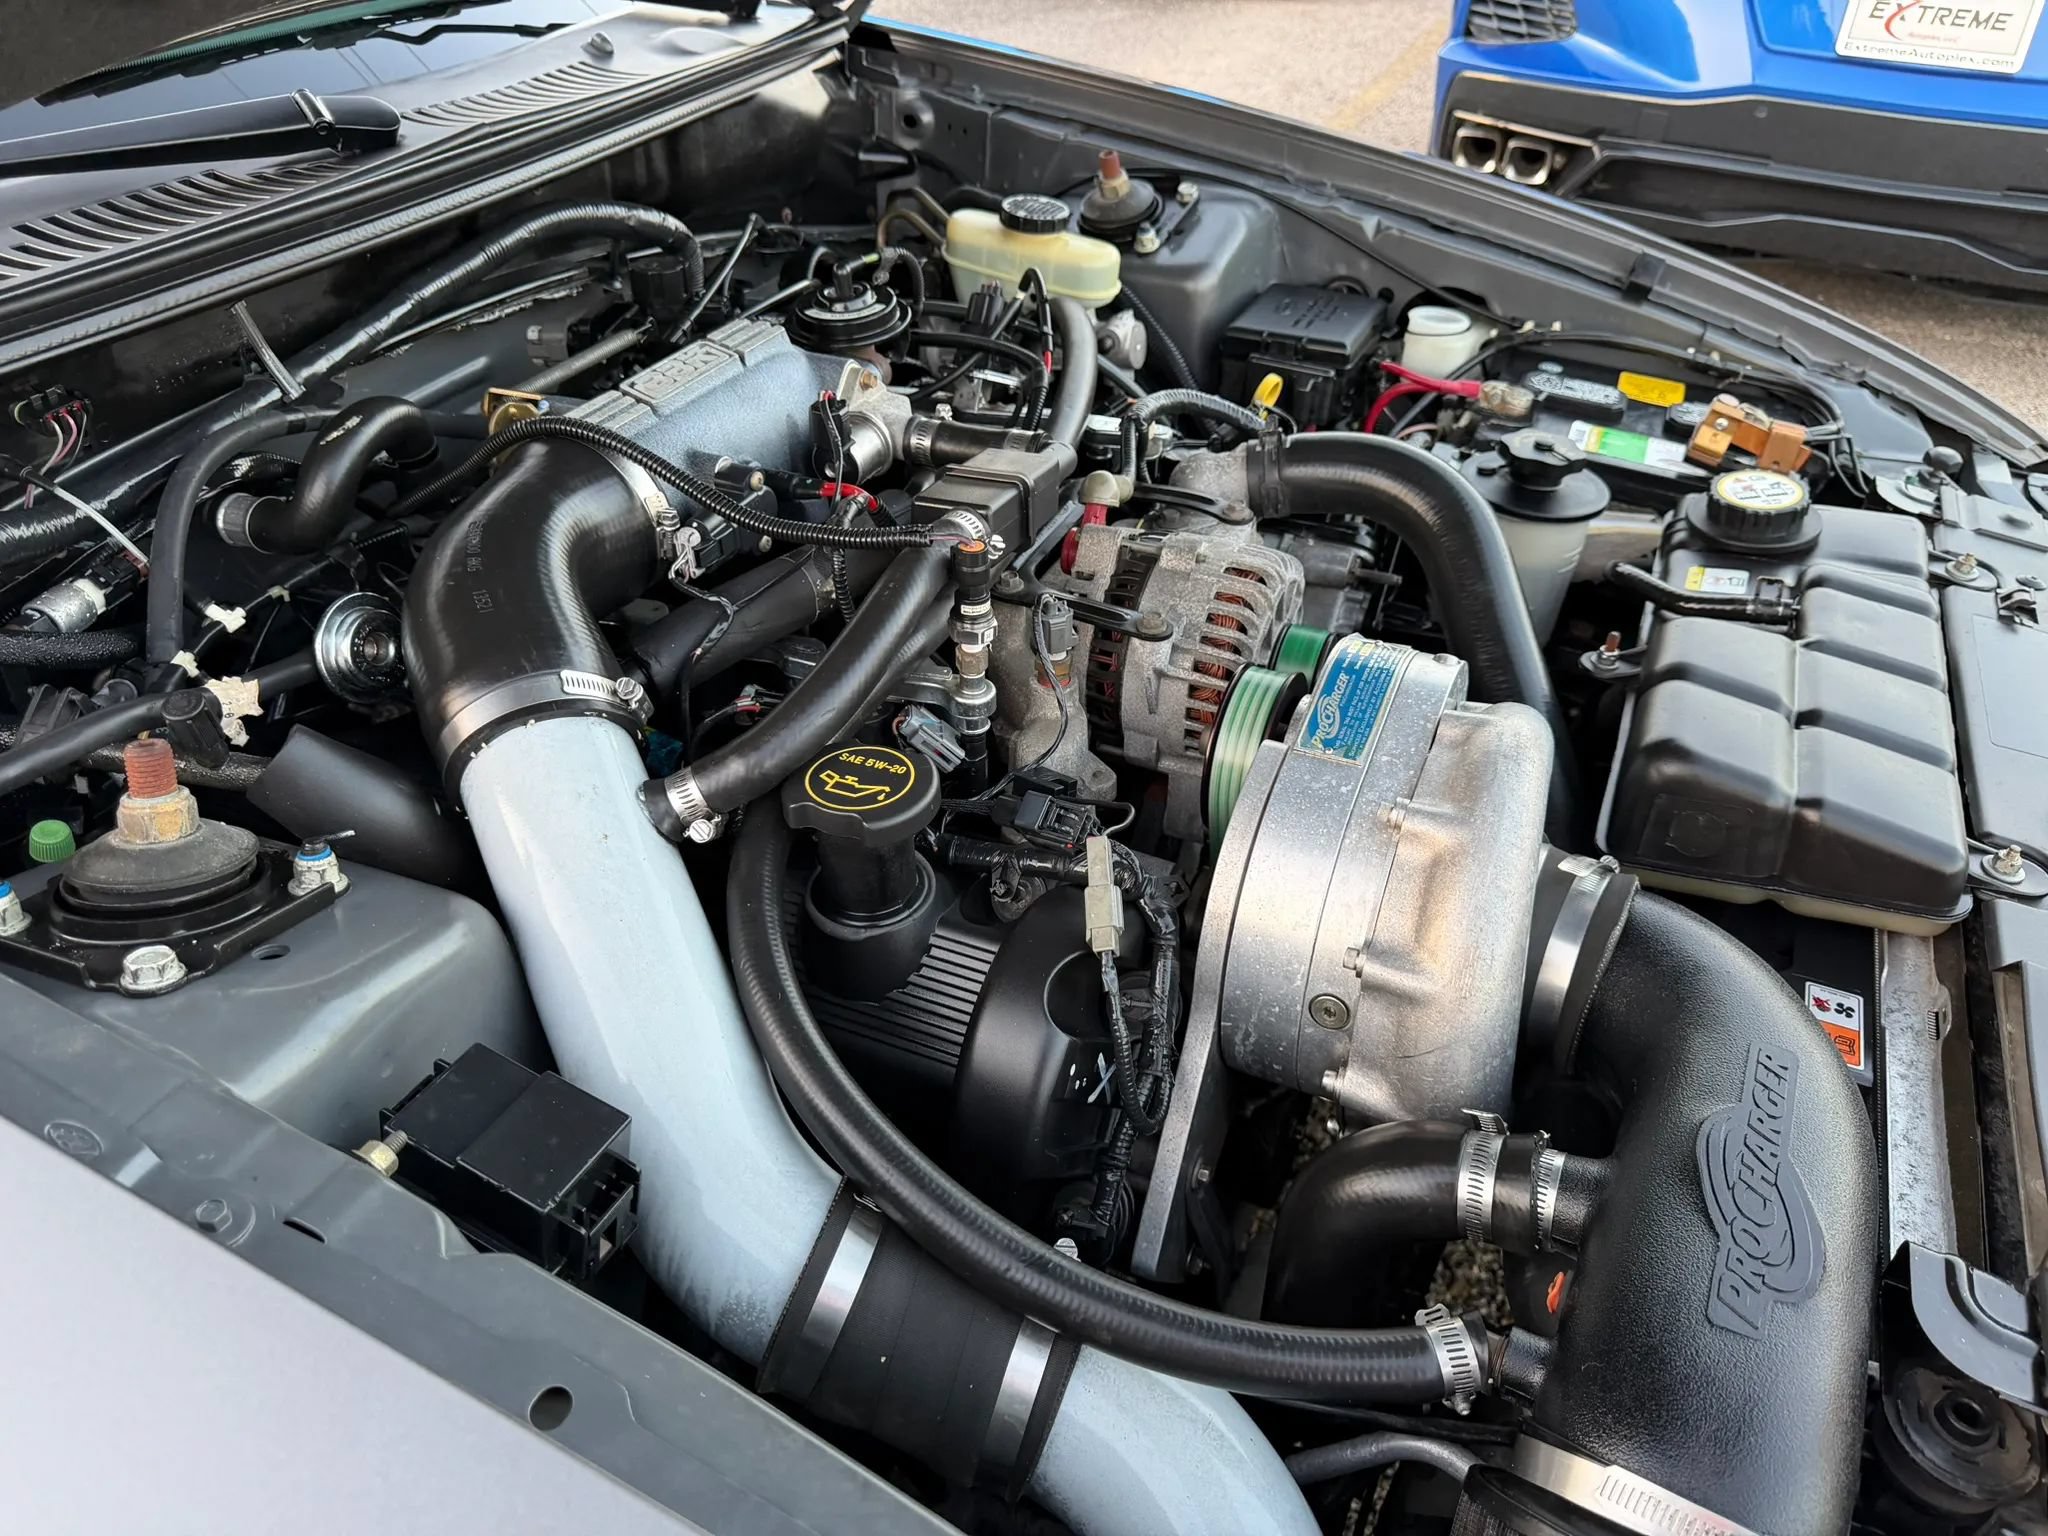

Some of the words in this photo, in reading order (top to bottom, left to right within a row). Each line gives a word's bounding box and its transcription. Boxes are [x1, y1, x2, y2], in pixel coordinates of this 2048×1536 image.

[1868, 0, 2014, 33] EXTREME
[1311, 671, 1350, 751] PROCHARGER
[838, 752, 864, 765] SAE
[865, 758, 907, 775] 5W-20
[1715, 1046, 1790, 1331] PROCHARGER
